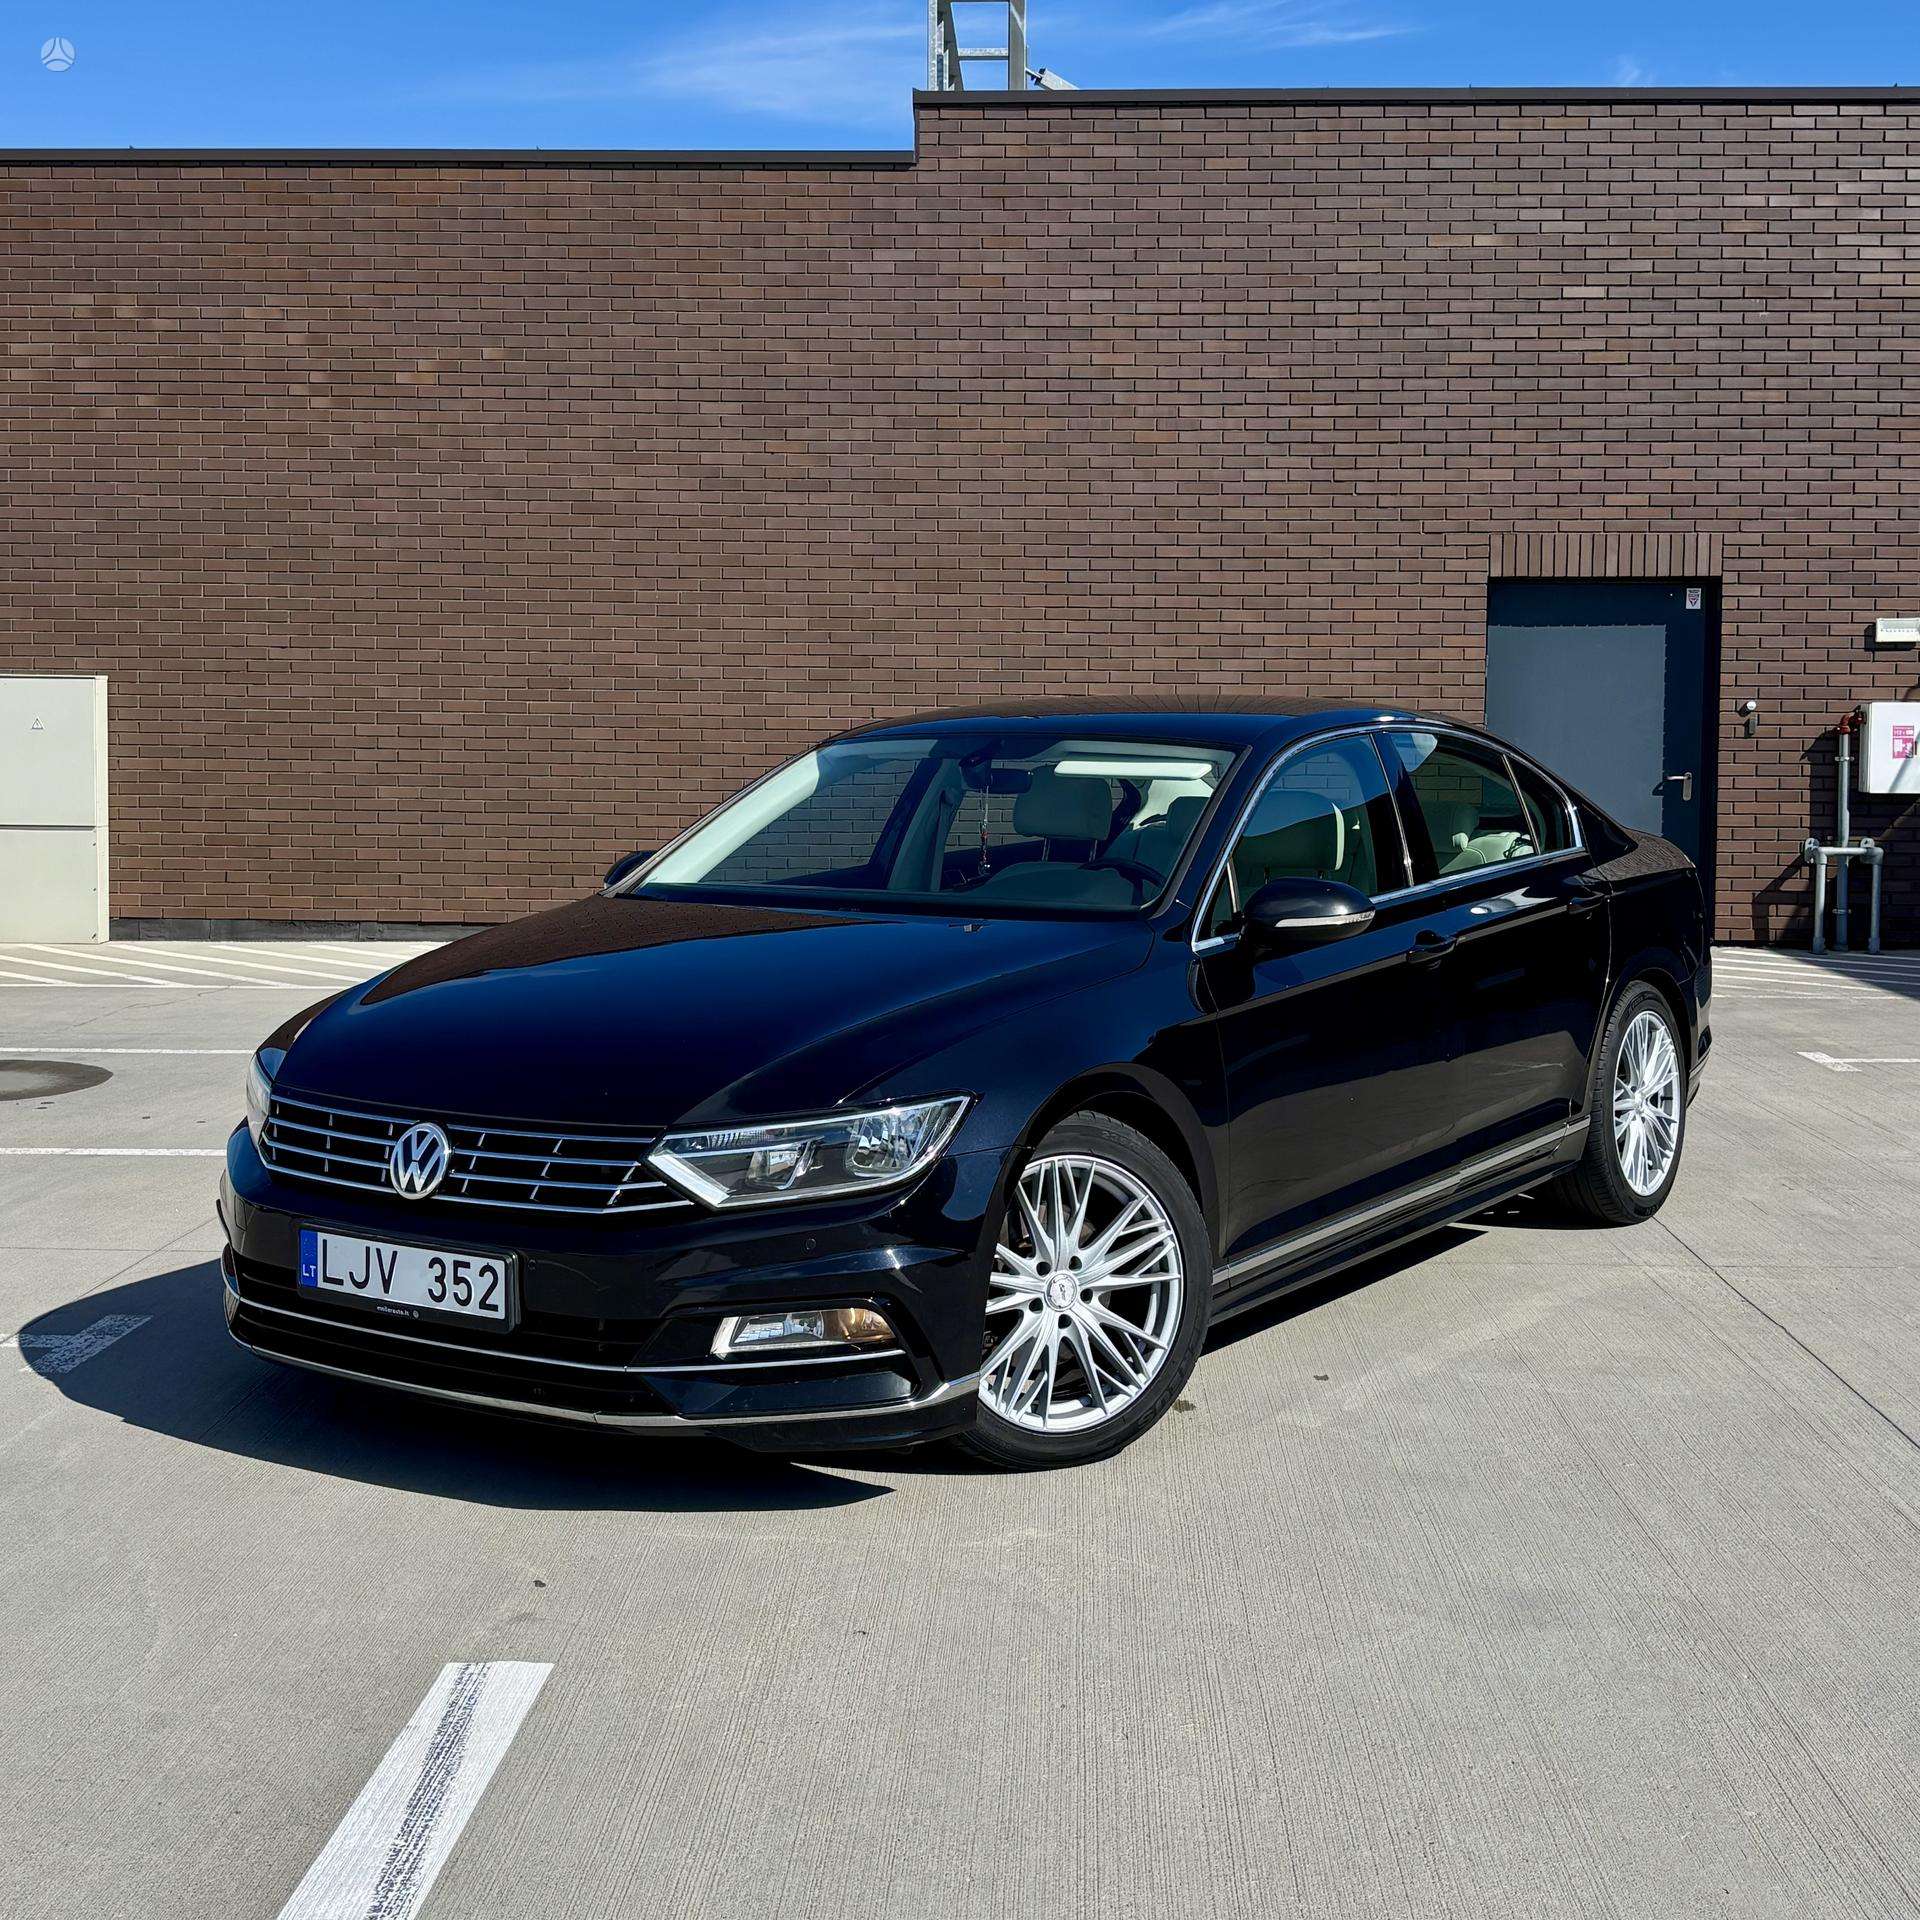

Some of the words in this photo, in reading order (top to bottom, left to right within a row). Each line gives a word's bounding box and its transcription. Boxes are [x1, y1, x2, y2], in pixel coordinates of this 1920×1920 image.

[393, 1125, 444, 1195] VW
[302, 1264, 317, 1278] LT
[322, 1238, 398, 1295] LJV
[427, 1256, 499, 1312] 352
